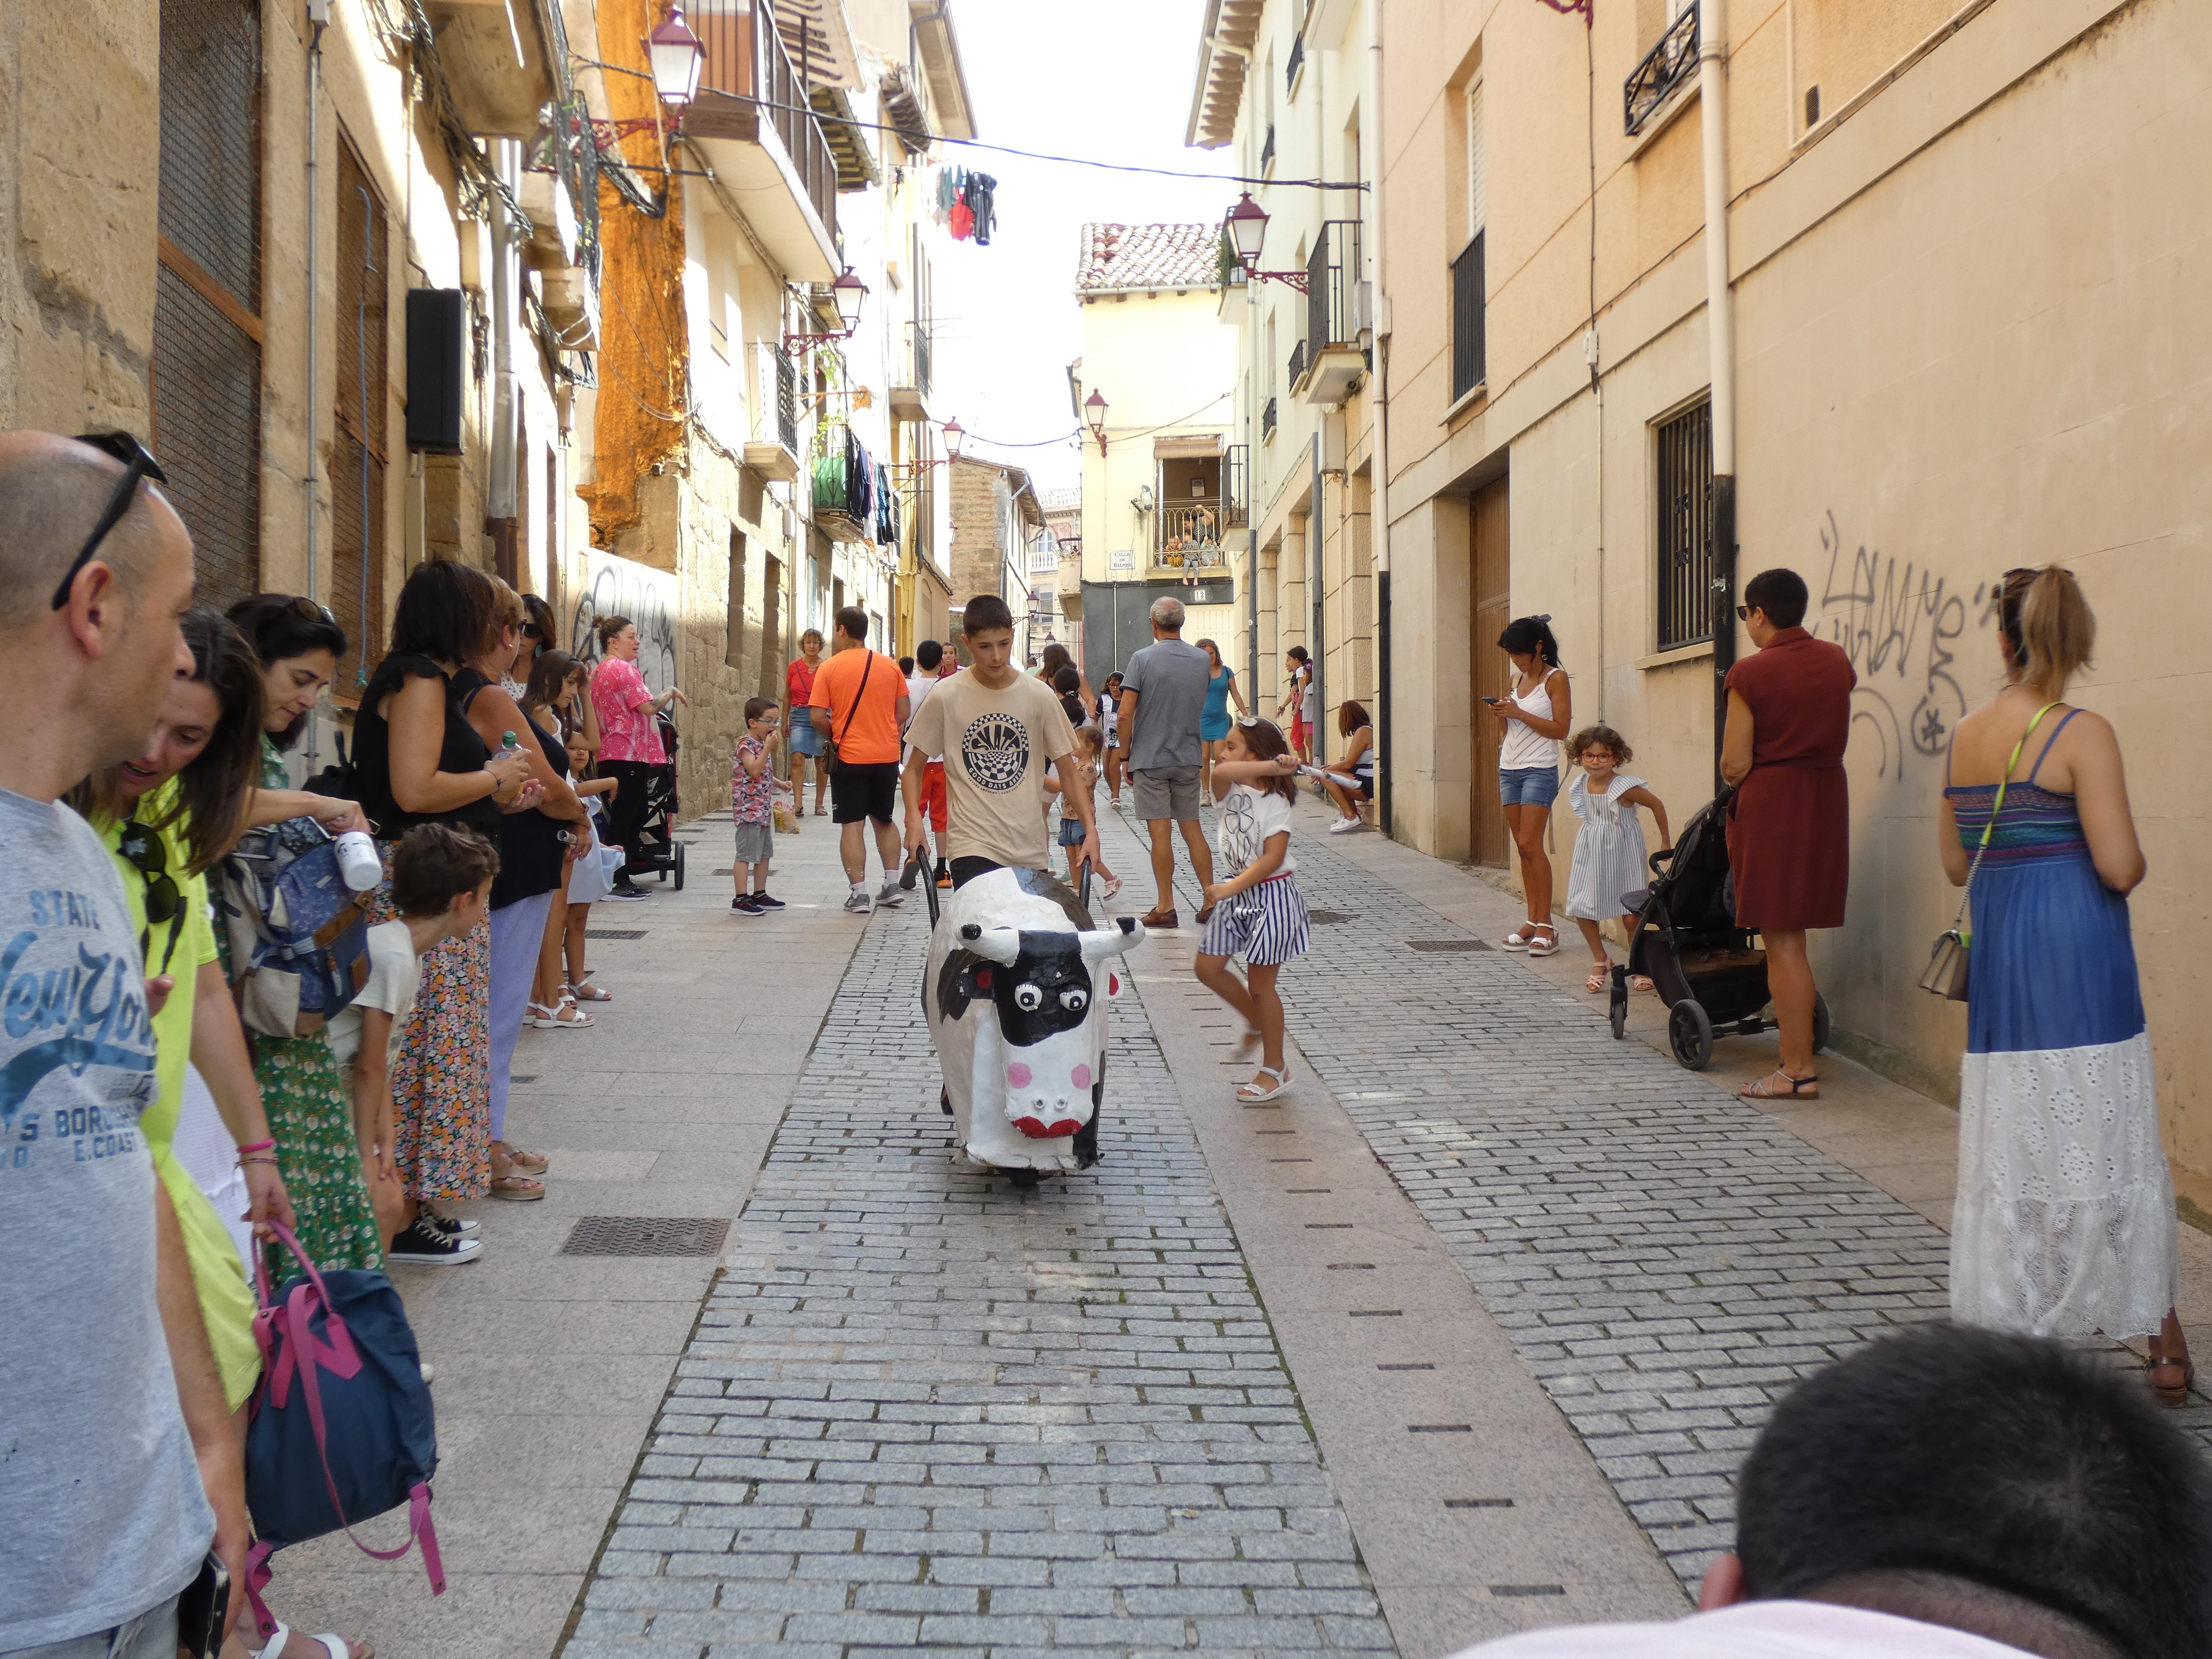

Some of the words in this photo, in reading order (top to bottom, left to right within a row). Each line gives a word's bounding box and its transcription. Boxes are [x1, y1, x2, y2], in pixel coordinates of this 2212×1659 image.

[971, 724, 1020, 751] SKATE
[968, 768, 986, 785] GOOD
[1009, 767, 1024, 787] AHEAD
